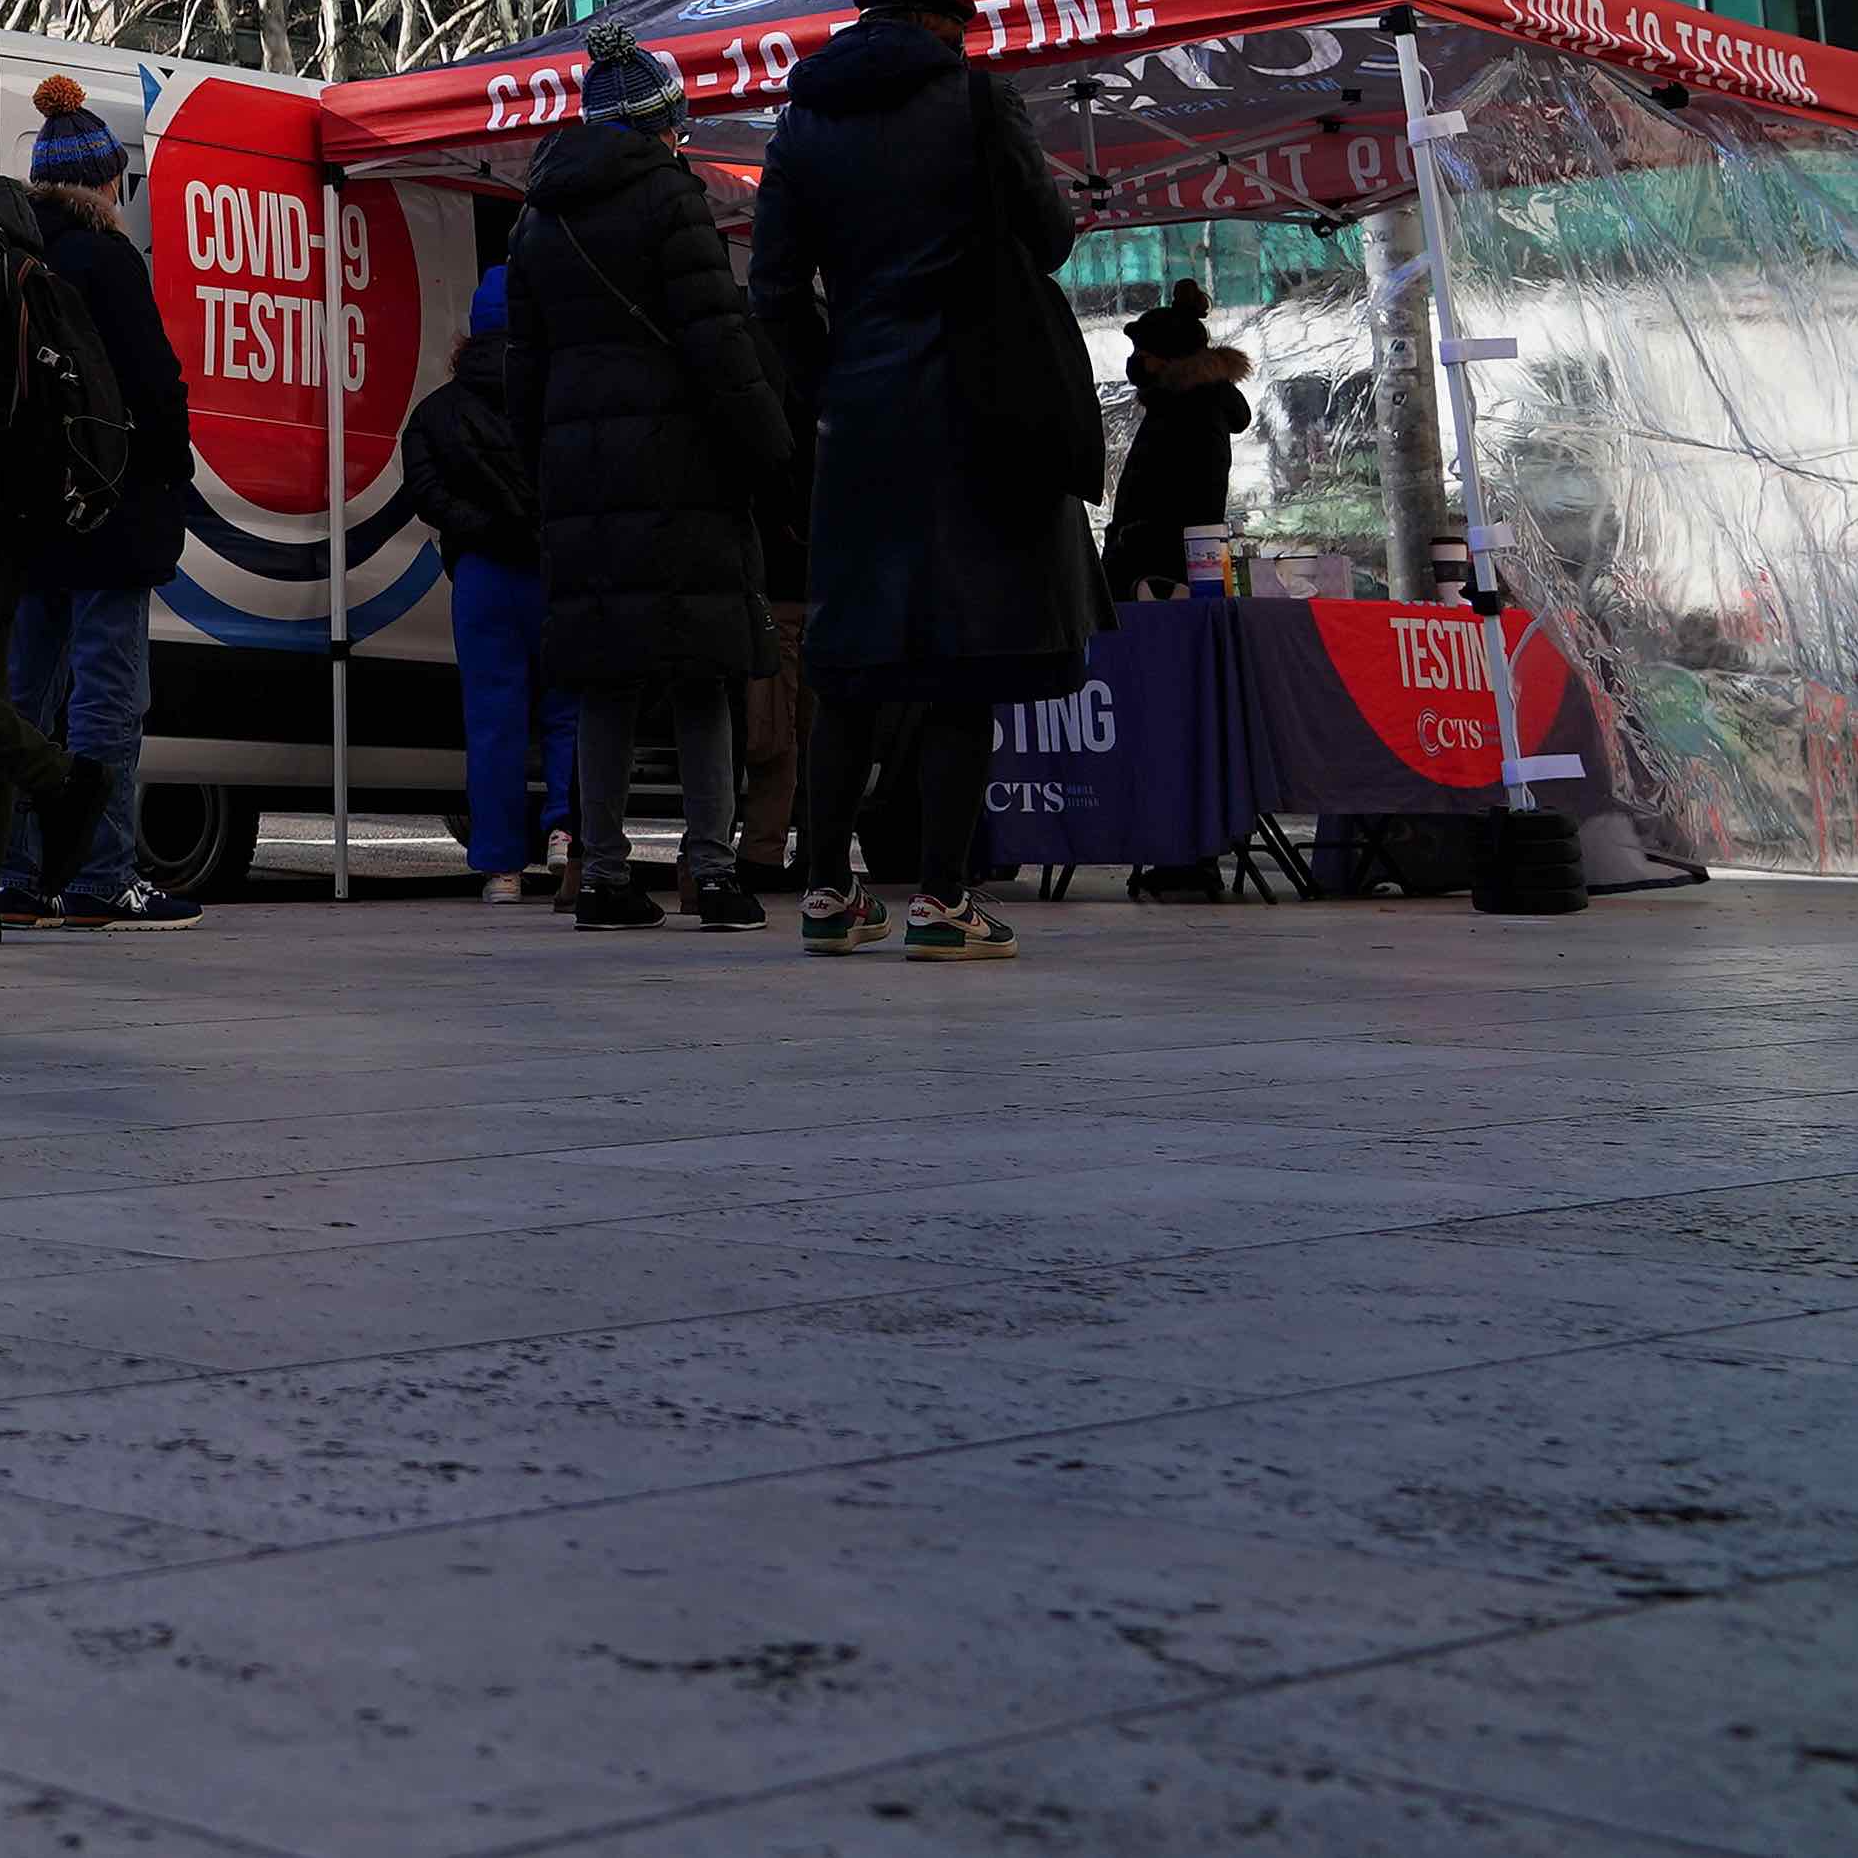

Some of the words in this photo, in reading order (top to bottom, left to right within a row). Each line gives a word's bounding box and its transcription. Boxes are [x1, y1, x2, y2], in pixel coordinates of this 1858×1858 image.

[1675, 21, 1819, 107] TESTING
[185, 180, 370, 291] COVID-9
[1390, 617, 1494, 691] TESTIN
[985, 781, 1065, 813] CTS
